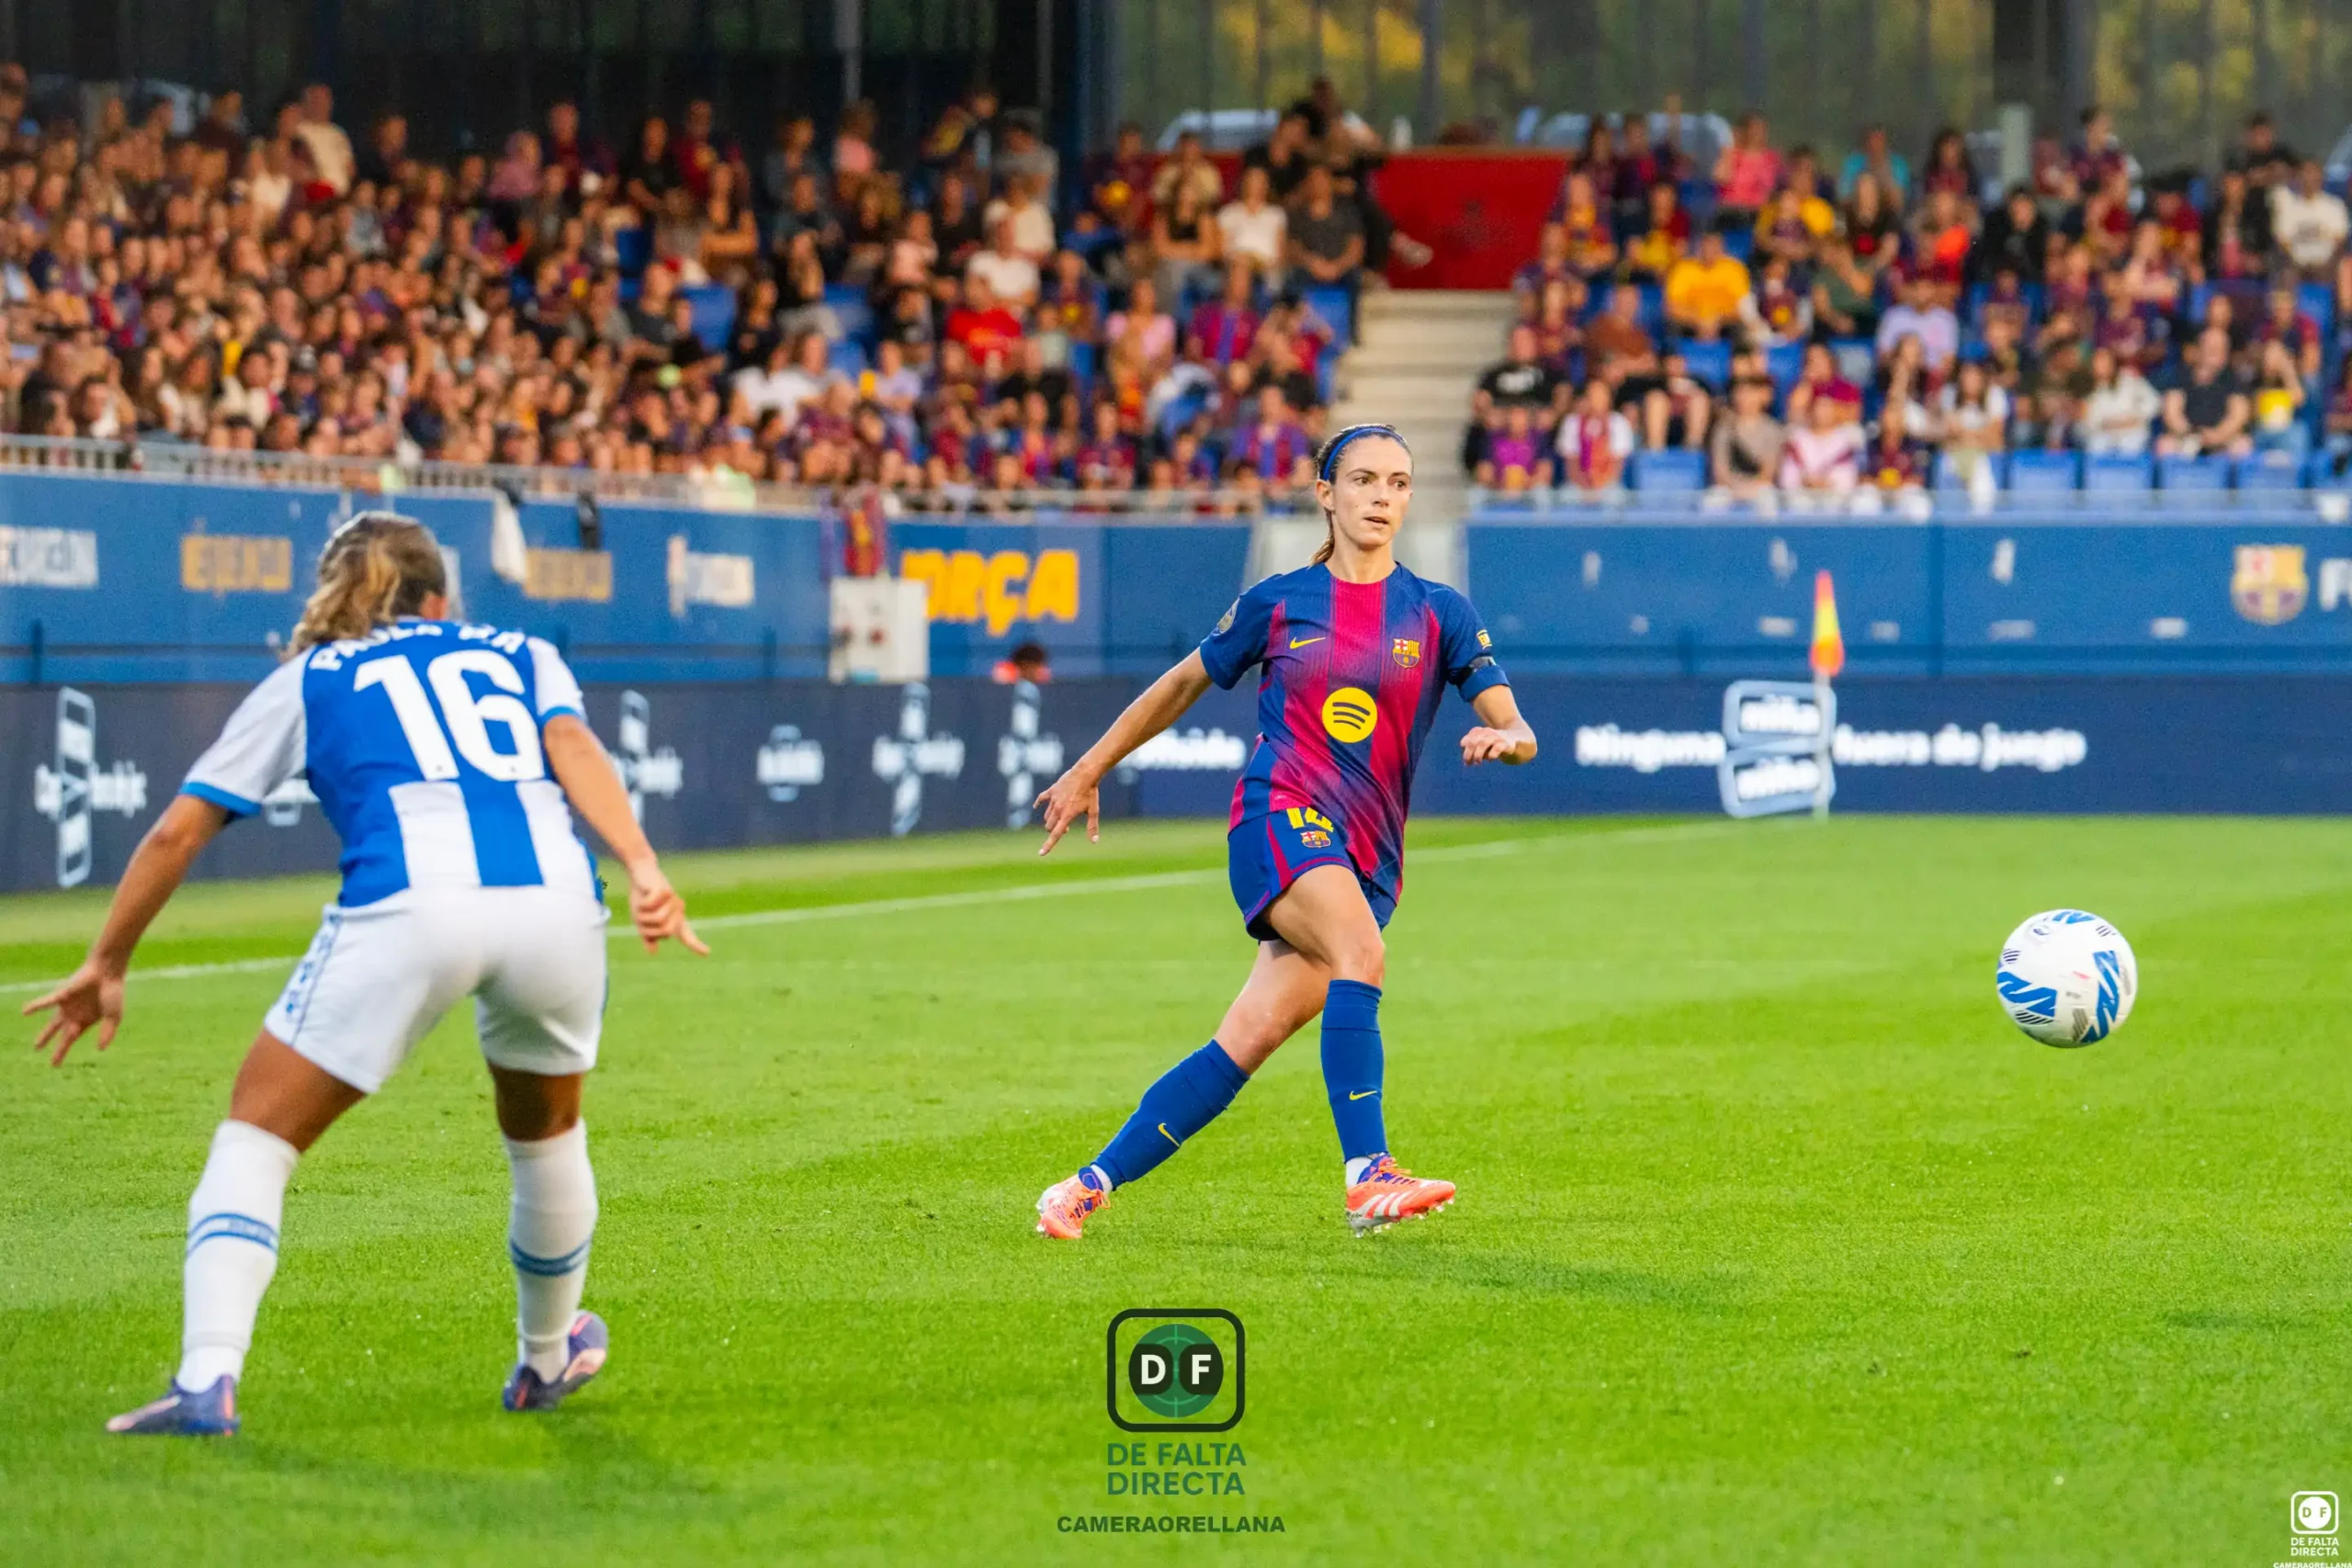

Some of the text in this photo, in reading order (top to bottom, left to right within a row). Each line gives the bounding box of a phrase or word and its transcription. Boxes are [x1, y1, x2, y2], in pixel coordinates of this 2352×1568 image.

[353, 649, 545, 781] 16
[1575, 724, 1727, 773] Ninguna
[1933, 723, 1981, 765] de
[1981, 722, 2087, 773] juego
